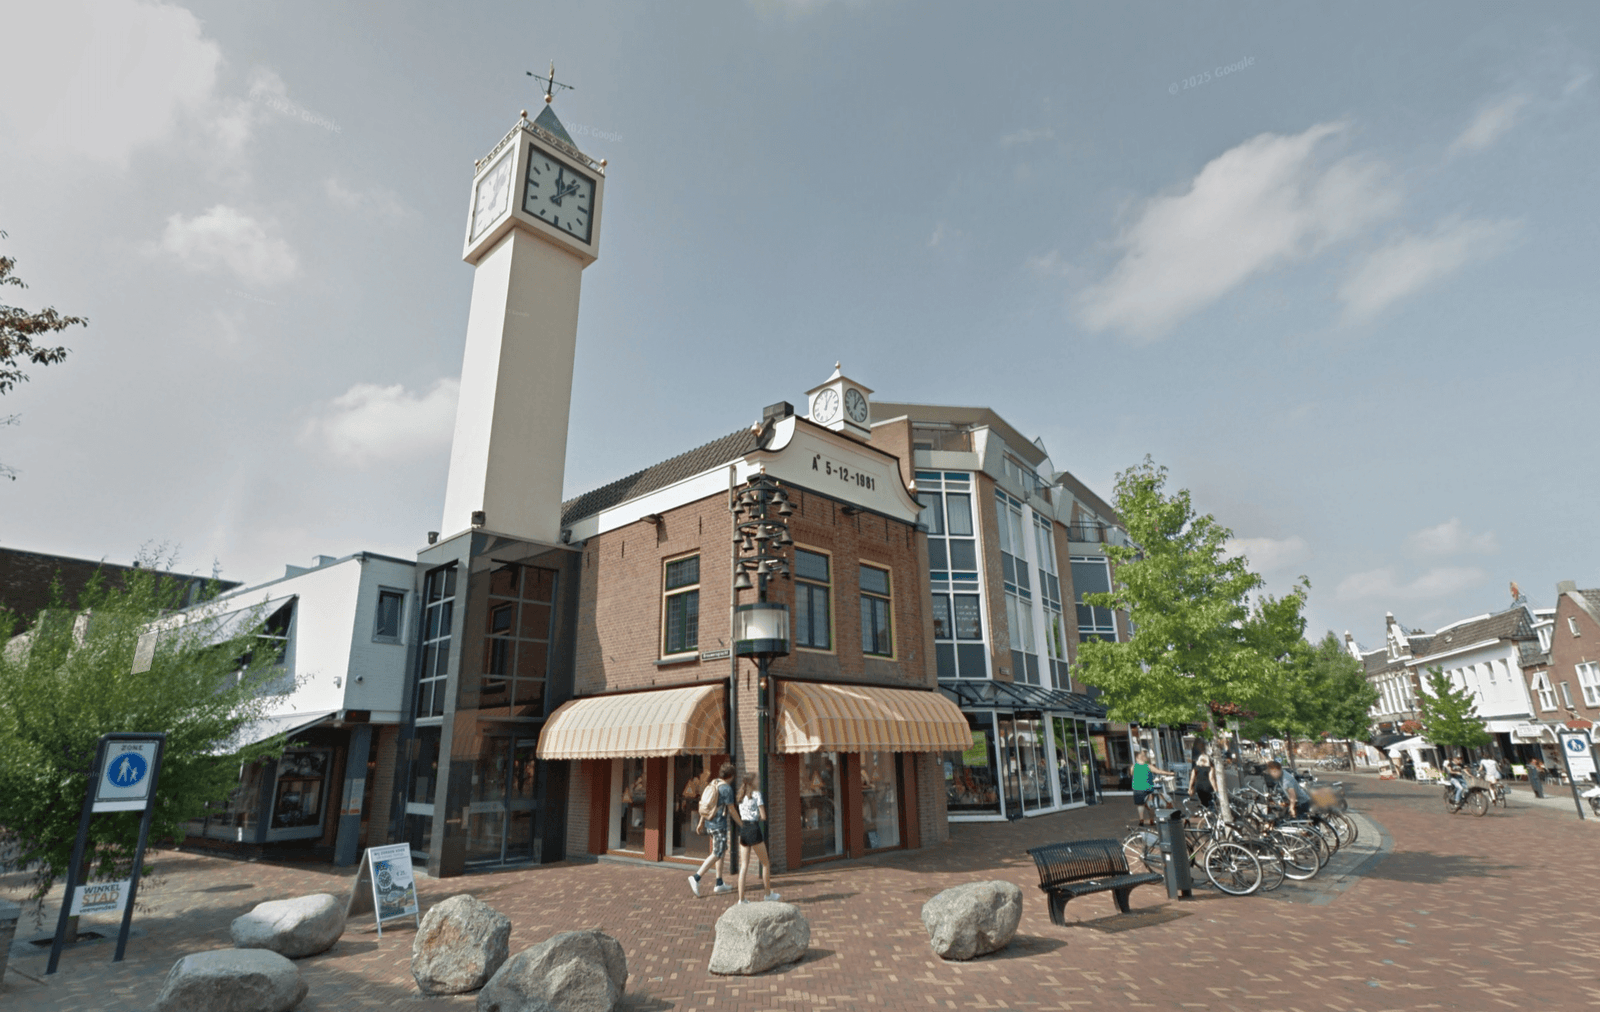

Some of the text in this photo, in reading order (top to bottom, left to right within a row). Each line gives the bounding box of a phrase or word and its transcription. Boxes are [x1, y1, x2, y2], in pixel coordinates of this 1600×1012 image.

[825, 461, 875, 491] 5-12-1981
[84, 884, 121, 894] WINKEL
[82, 891, 119, 905] STAD
